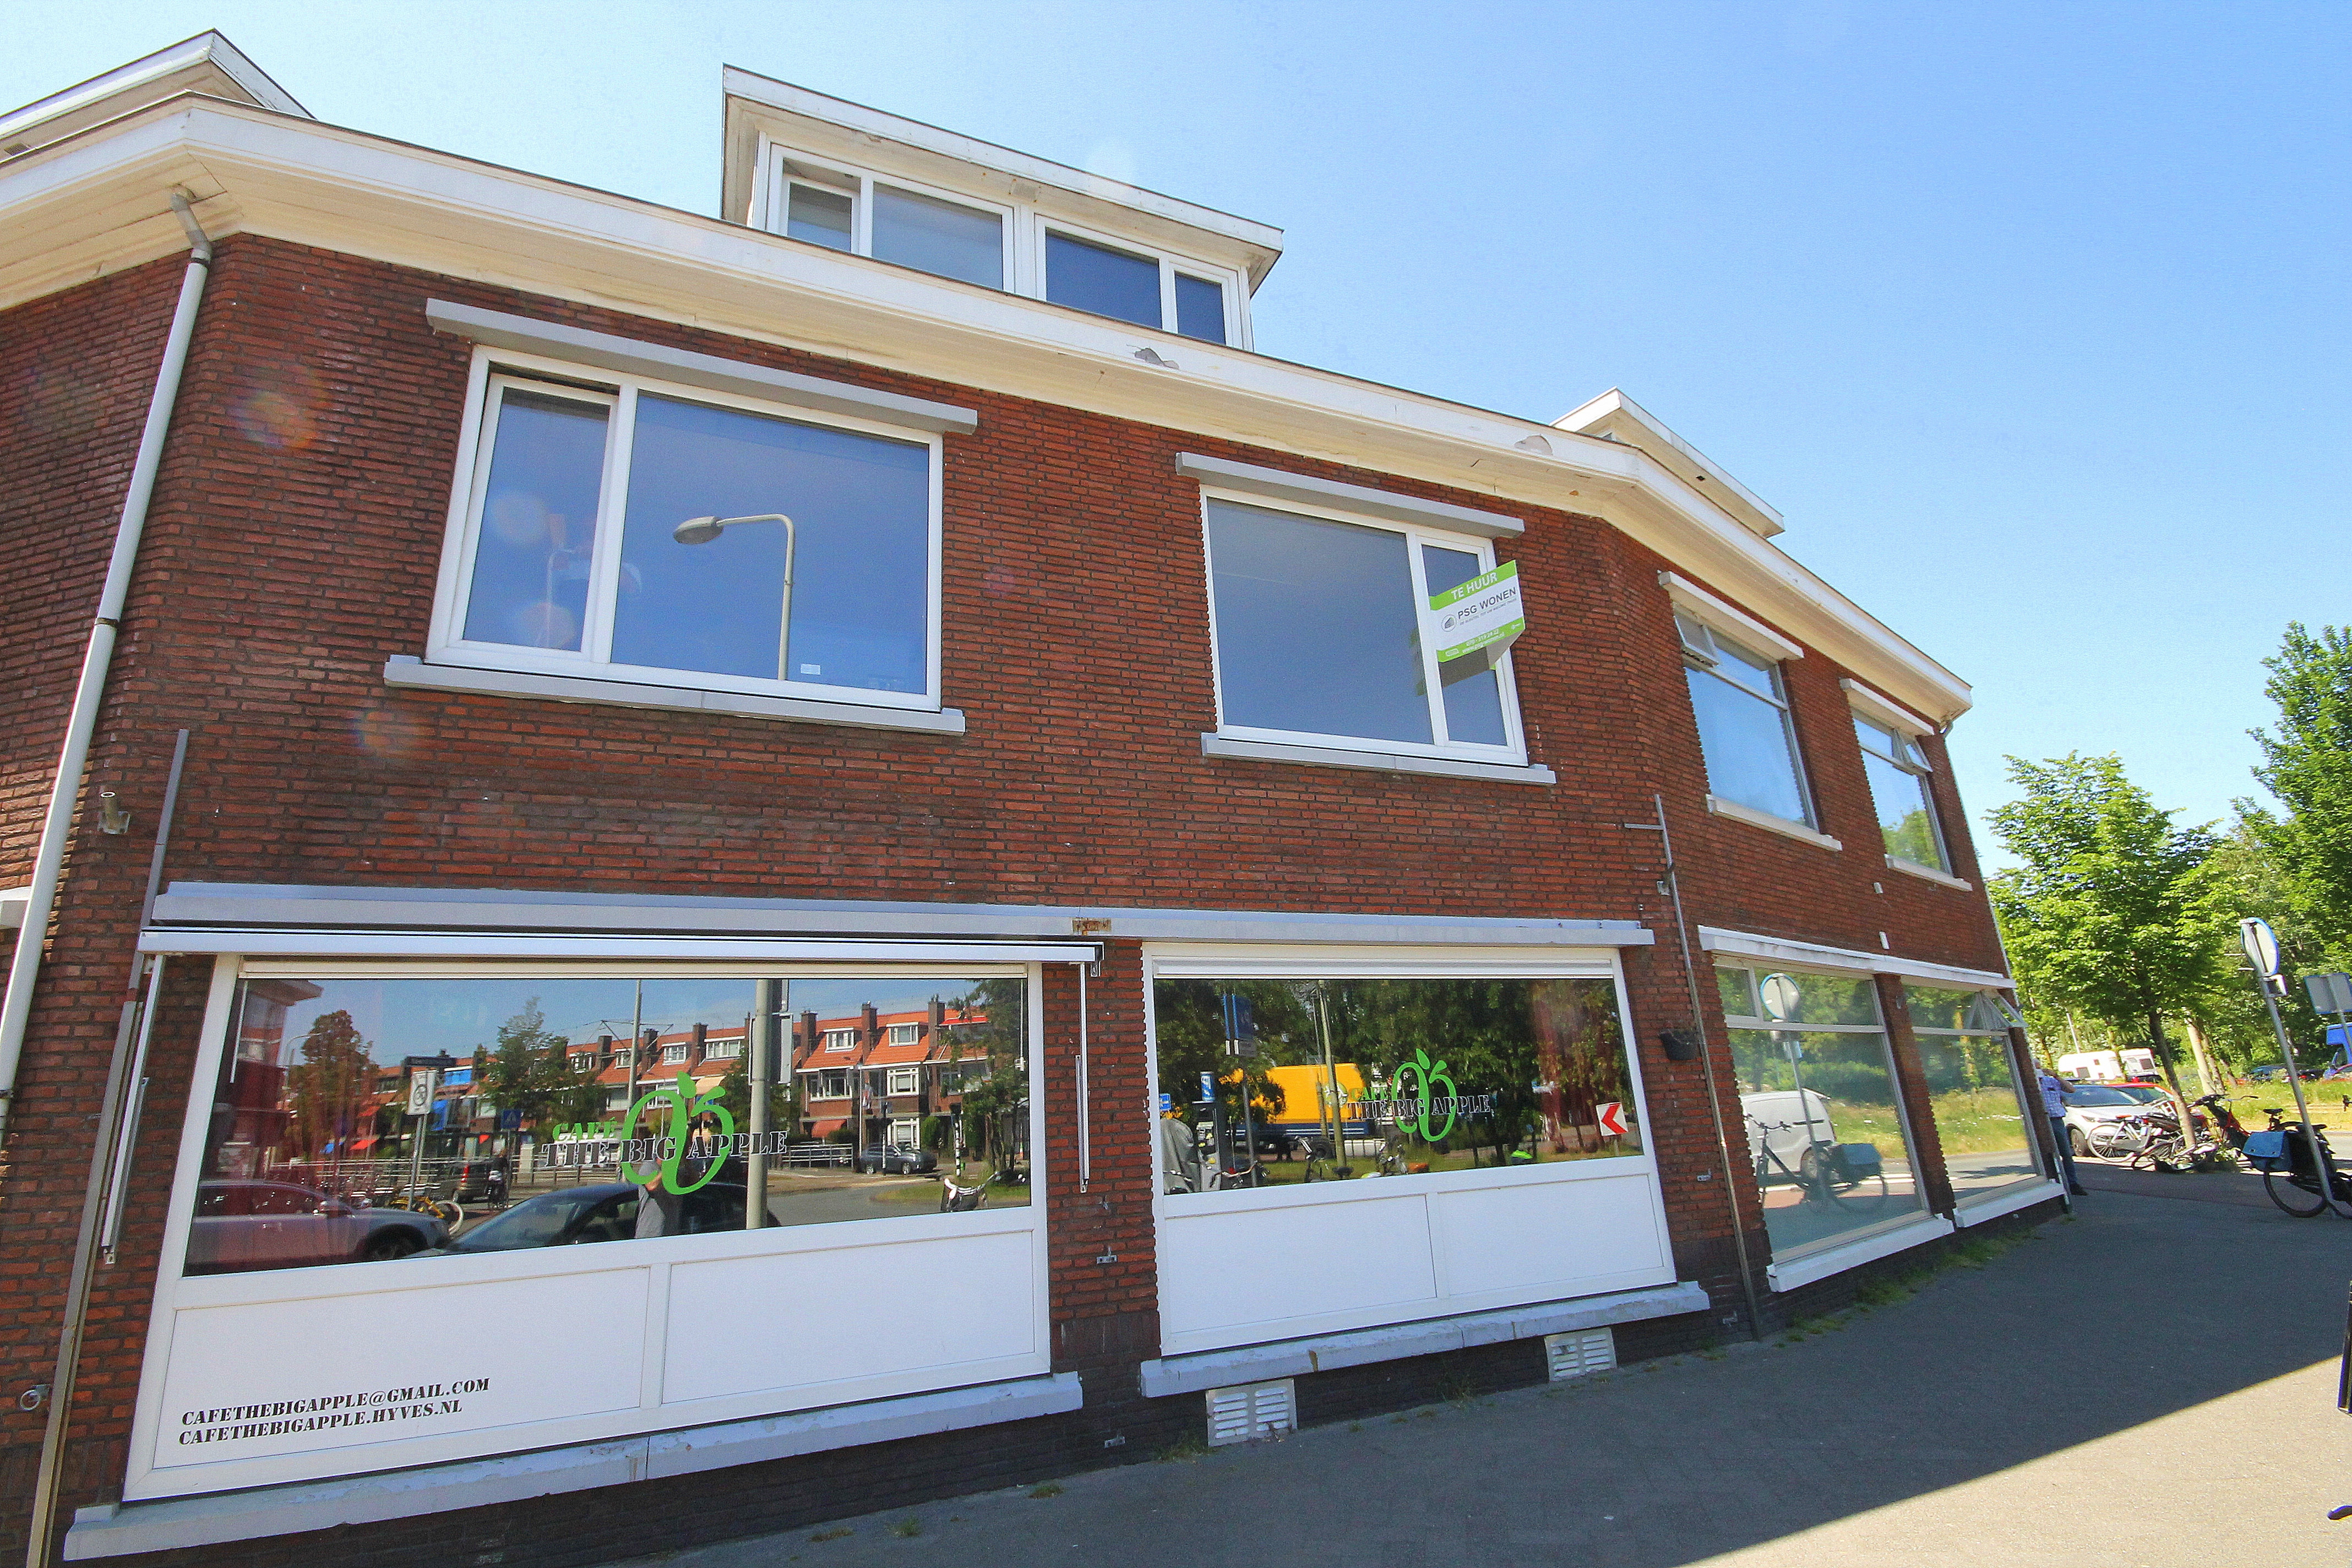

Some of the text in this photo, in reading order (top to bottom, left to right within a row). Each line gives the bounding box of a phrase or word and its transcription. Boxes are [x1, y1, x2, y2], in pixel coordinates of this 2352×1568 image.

[1451, 572, 1498, 600] TE HUUR
[1458, 605, 1477, 619] PSG
[1479, 587, 1516, 609] WONEN
[1348, 1095, 1490, 1120] THE BIG APPLE
[552, 1117, 618, 1140] CAFÉ
[542, 1131, 787, 1167] THE BIG APPLE
[181, 1378, 490, 1425] CAFETHEBIGAPPLE@GMAIL.COM
[178, 1400, 462, 1445] CAFETHEBIGAPPLE.HYVES.NL
